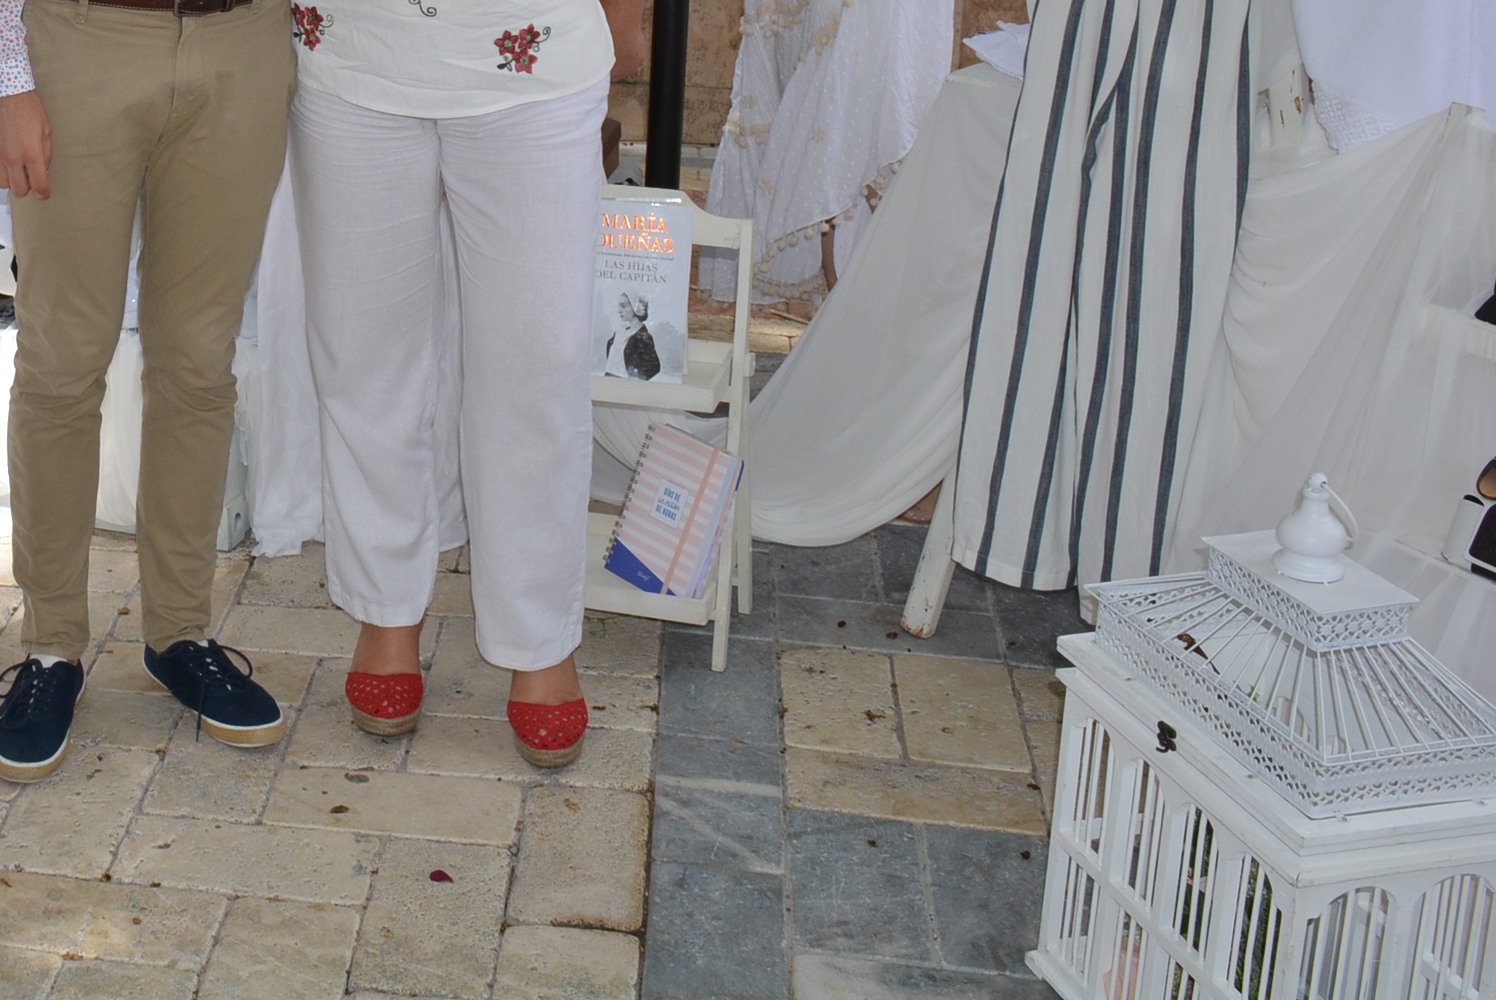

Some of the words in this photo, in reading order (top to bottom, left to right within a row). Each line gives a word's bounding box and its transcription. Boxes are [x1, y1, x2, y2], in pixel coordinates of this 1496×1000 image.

[601, 211, 668, 233] MARÍA
[605, 260, 624, 270] LAS
[627, 261, 658, 273] HIJAS
[619, 271, 667, 284] CAPITÁN
